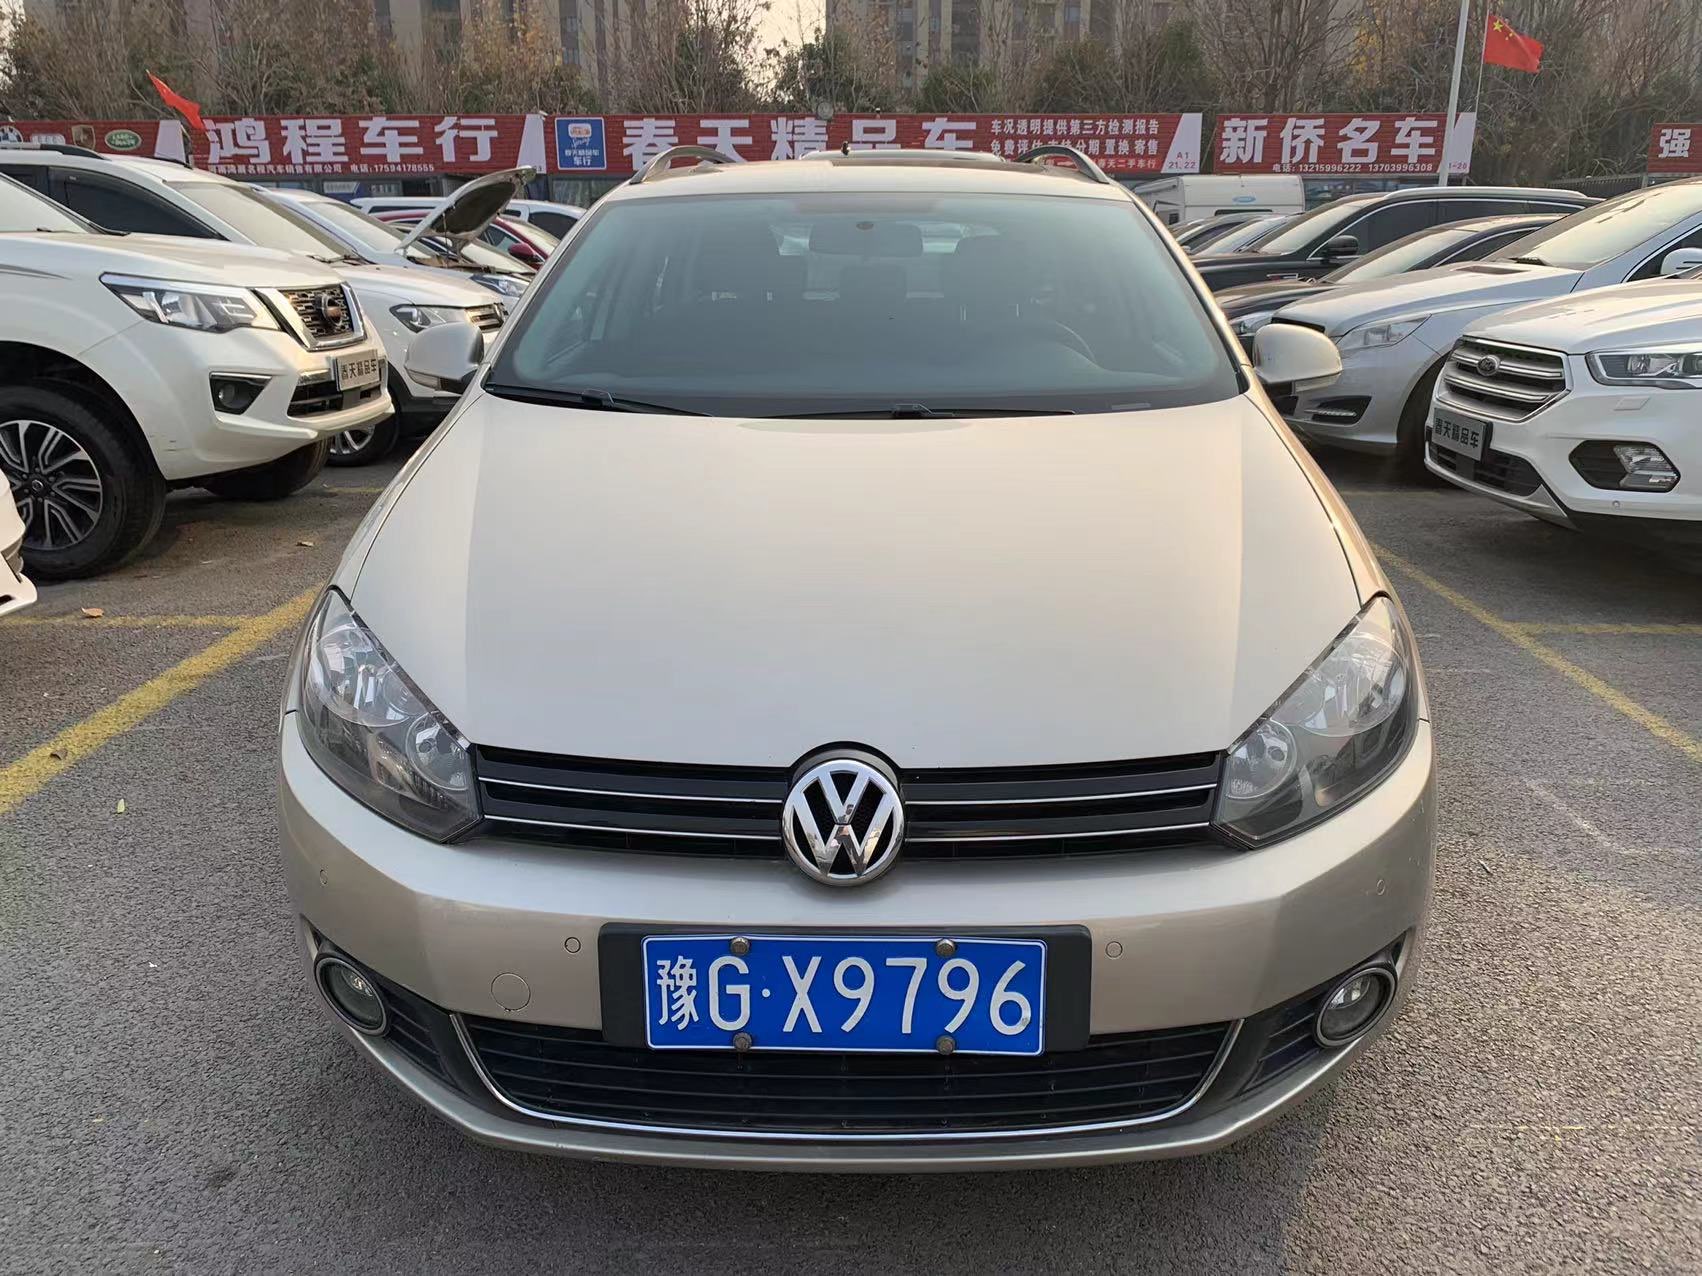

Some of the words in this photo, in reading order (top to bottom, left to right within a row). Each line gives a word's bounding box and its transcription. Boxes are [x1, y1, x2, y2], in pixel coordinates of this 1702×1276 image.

[203, 116, 498, 163] 鸿程车行
[991, 119, 1159, 135] 车况透明提供第三方检测报告
[1220, 117, 1438, 164] 新侨名车
[1658, 129, 1691, 157] 强
[1368, 163, 1433, 172] 13703996308
